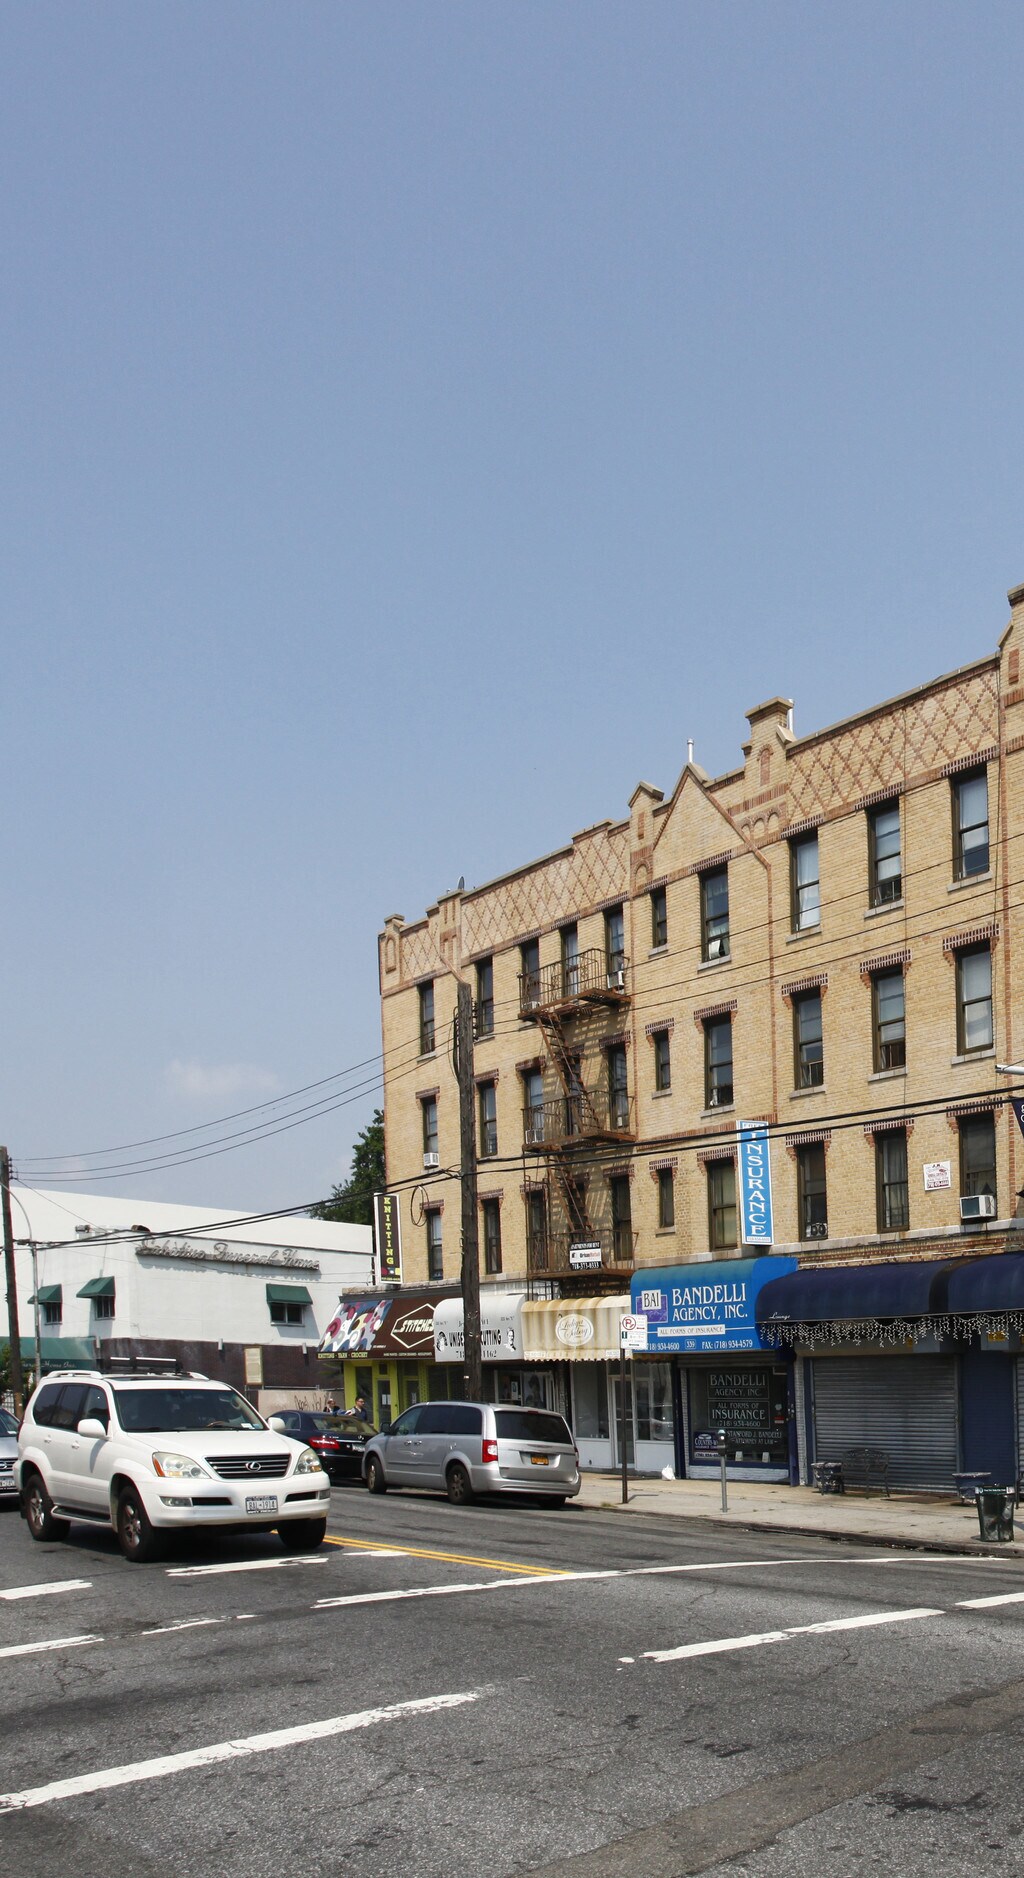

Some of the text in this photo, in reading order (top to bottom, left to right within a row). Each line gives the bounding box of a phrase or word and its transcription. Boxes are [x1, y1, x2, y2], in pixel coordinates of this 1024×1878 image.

[746, 1132, 767, 1236] INSURANCE
[383, 1196, 394, 1265] KNITTING
[643, 1292, 660, 1308] BAI
[672, 1283, 746, 1306] BANDELLI
[672, 1303, 748, 1322] AGENCY, INC.
[448, 1332, 464, 1347] UNISE
[710, 1374, 766, 1386] BANDELLI
[711, 1409, 766, 1420] INSURANCE
